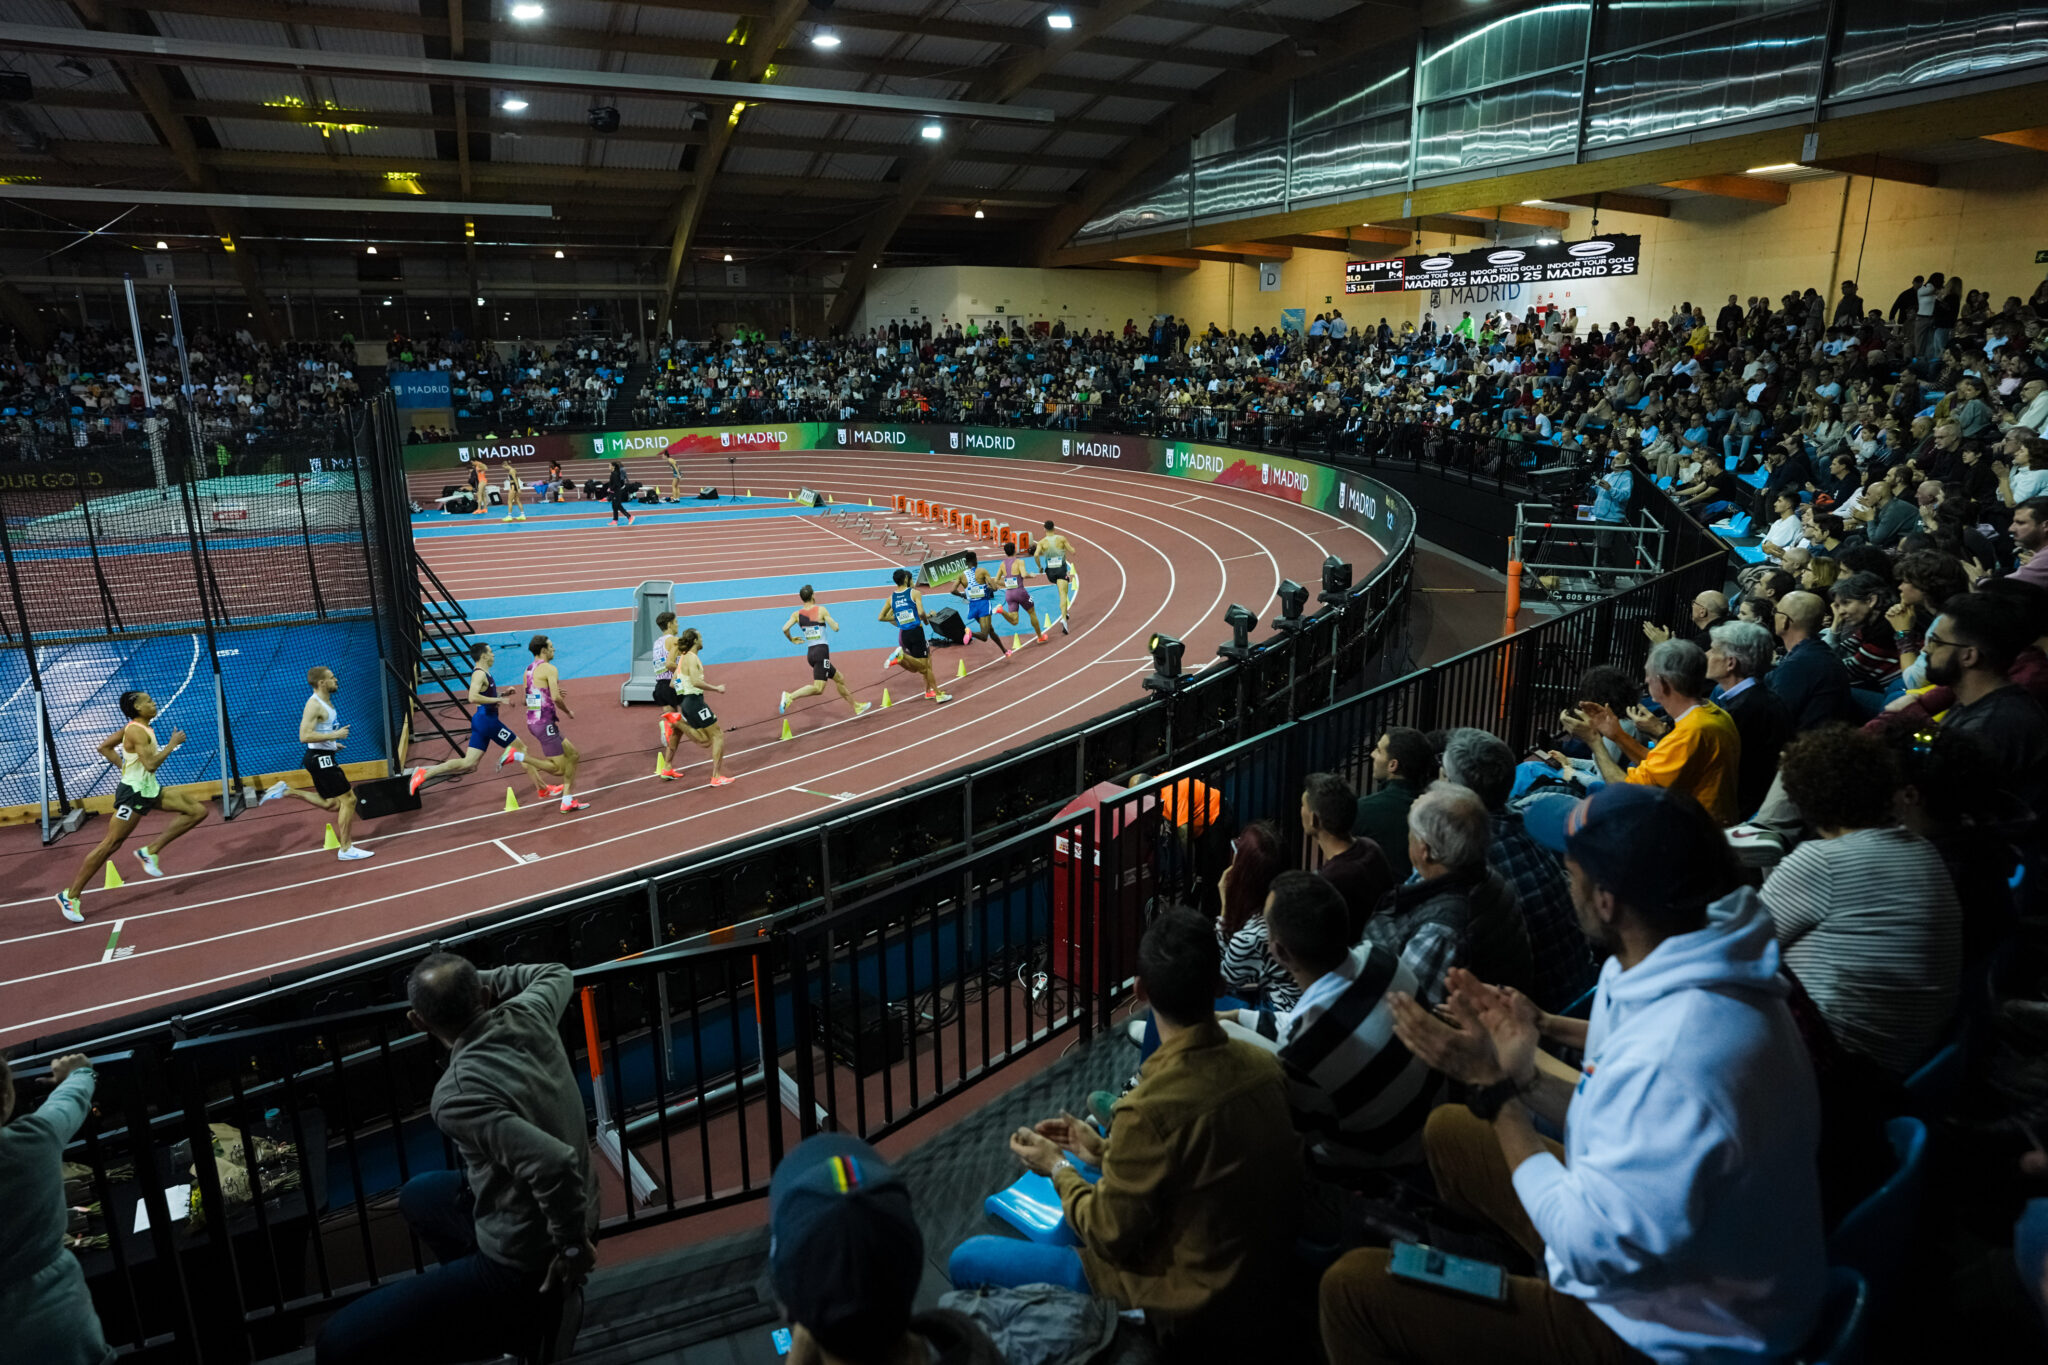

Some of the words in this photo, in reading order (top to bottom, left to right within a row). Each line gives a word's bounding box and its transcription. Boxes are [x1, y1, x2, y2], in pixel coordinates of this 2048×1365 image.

[1347, 261, 1403, 273] FILIPIC
[1547, 261, 1581, 269] INDOOR
[1608, 256, 1635, 264] GOLD
[1405, 273, 1430, 281] INDOOR
[1449, 270, 1467, 278] GOLD
[1470, 268, 1498, 276] INDOOR
[1499, 266, 1519, 274] TOUR
[1546, 265, 1608, 279] MADRID
[1611, 263, 1634, 274] 25
[1266, 272, 1277, 286] D
[1346, 274, 1361, 282] SLO
[1404, 278, 1449, 290] MADRID
[1451, 277, 1467, 286] 25
[1470, 272, 1520, 285] MADRID
[1523, 270, 1542, 281] 25
[1451, 283, 1520, 304] MADRID
[407, 385, 449, 395] MADRID
[611, 436, 670, 451] MADRID
[736, 431, 788, 444] MADRID
[854, 430, 906, 445] MADRID
[965, 433, 1016, 450] MADRID
[477, 444, 536, 461] MADRID
[1075, 442, 1122, 459] MADRID
[1179, 451, 1224, 473] MADRID
[1273, 467, 1309, 492] MADRID
[1349, 487, 1377, 520] MADRID
[932, 507, 938, 517] 6
[951, 512, 957, 522] 5
[966, 517, 971, 528] 4
[983, 523, 989, 534] 3
[1002, 530, 1009, 541] 2
[1022, 535, 1027, 547] 1
[1565, 593, 1582, 601] 605
[700, 709, 707, 718] 7
[499, 730, 509, 739] 3
[320, 756, 331, 767] 10
[118, 807, 130, 818] 2
